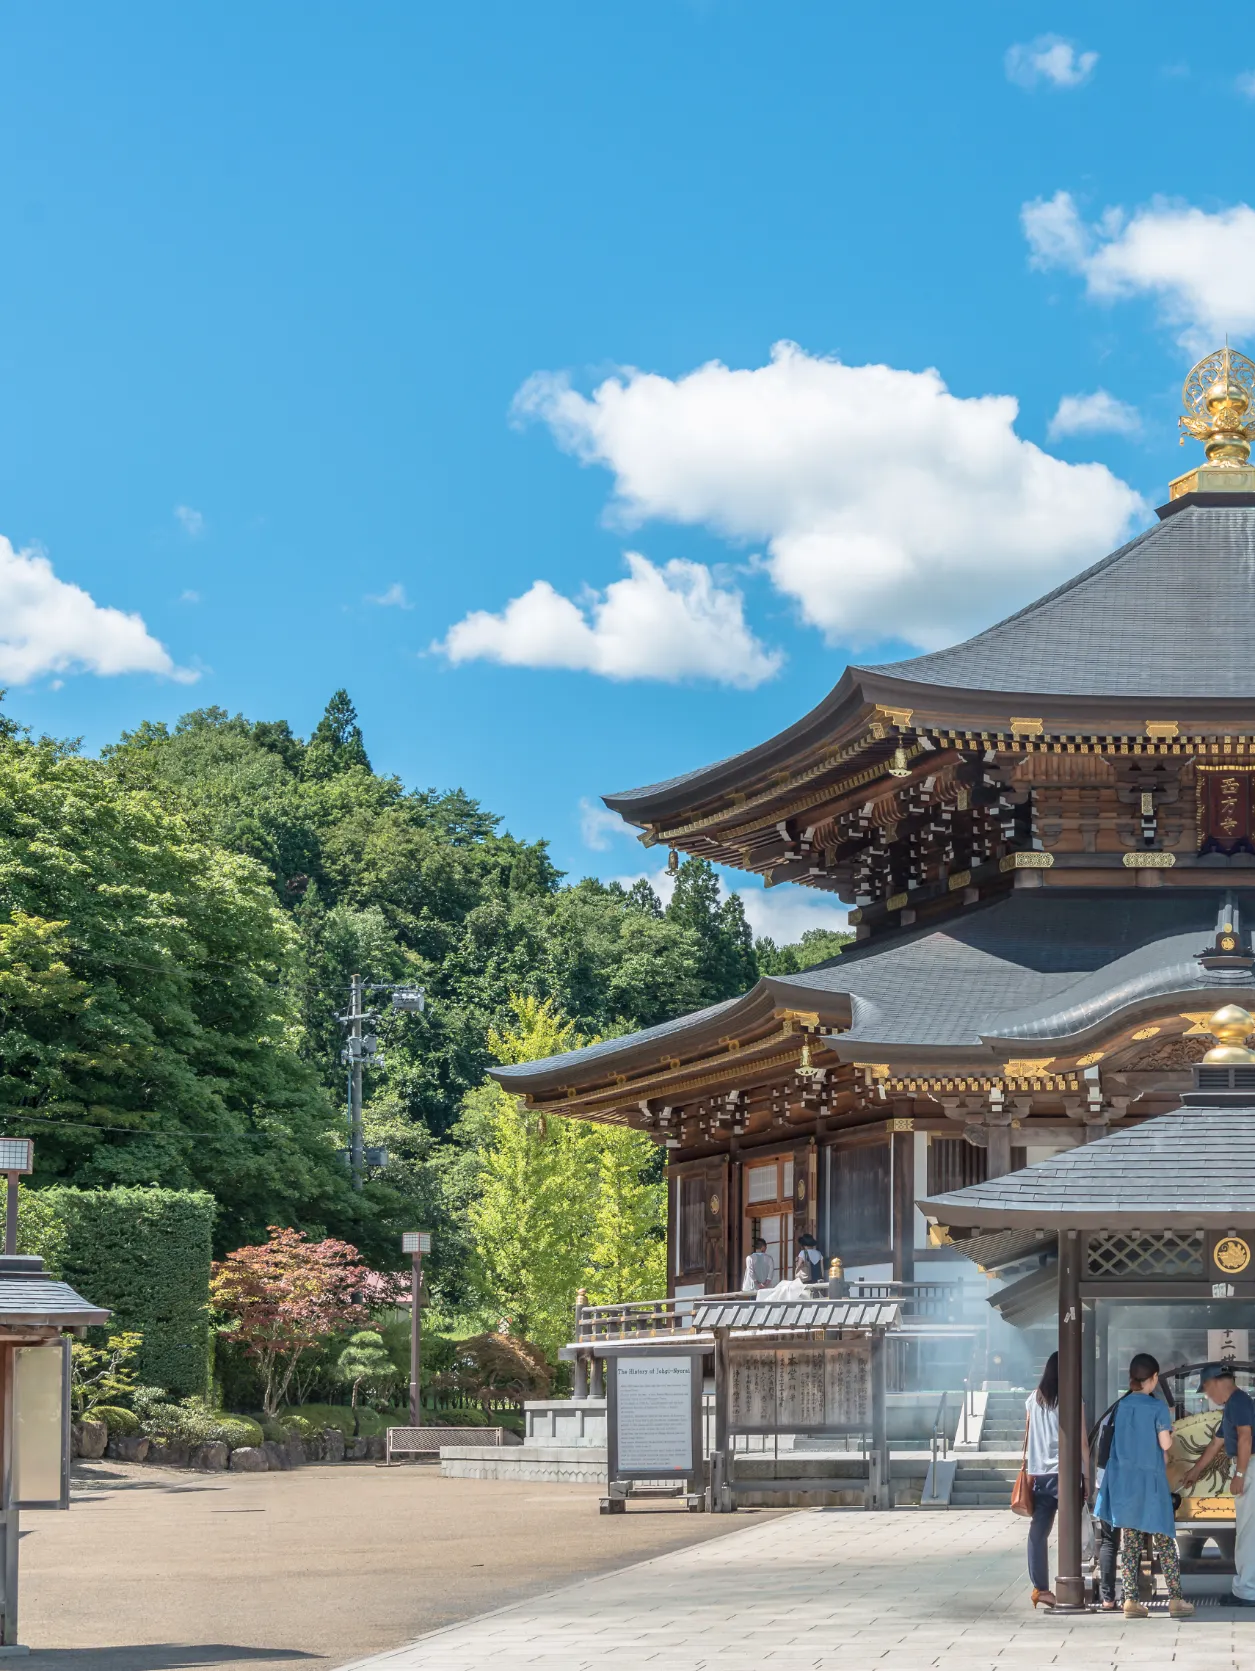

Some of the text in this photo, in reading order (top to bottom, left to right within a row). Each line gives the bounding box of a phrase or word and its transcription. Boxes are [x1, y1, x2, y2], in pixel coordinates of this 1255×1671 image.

[1220, 777, 1239, 836] 西方寺
[629, 1368, 648, 1376] History
